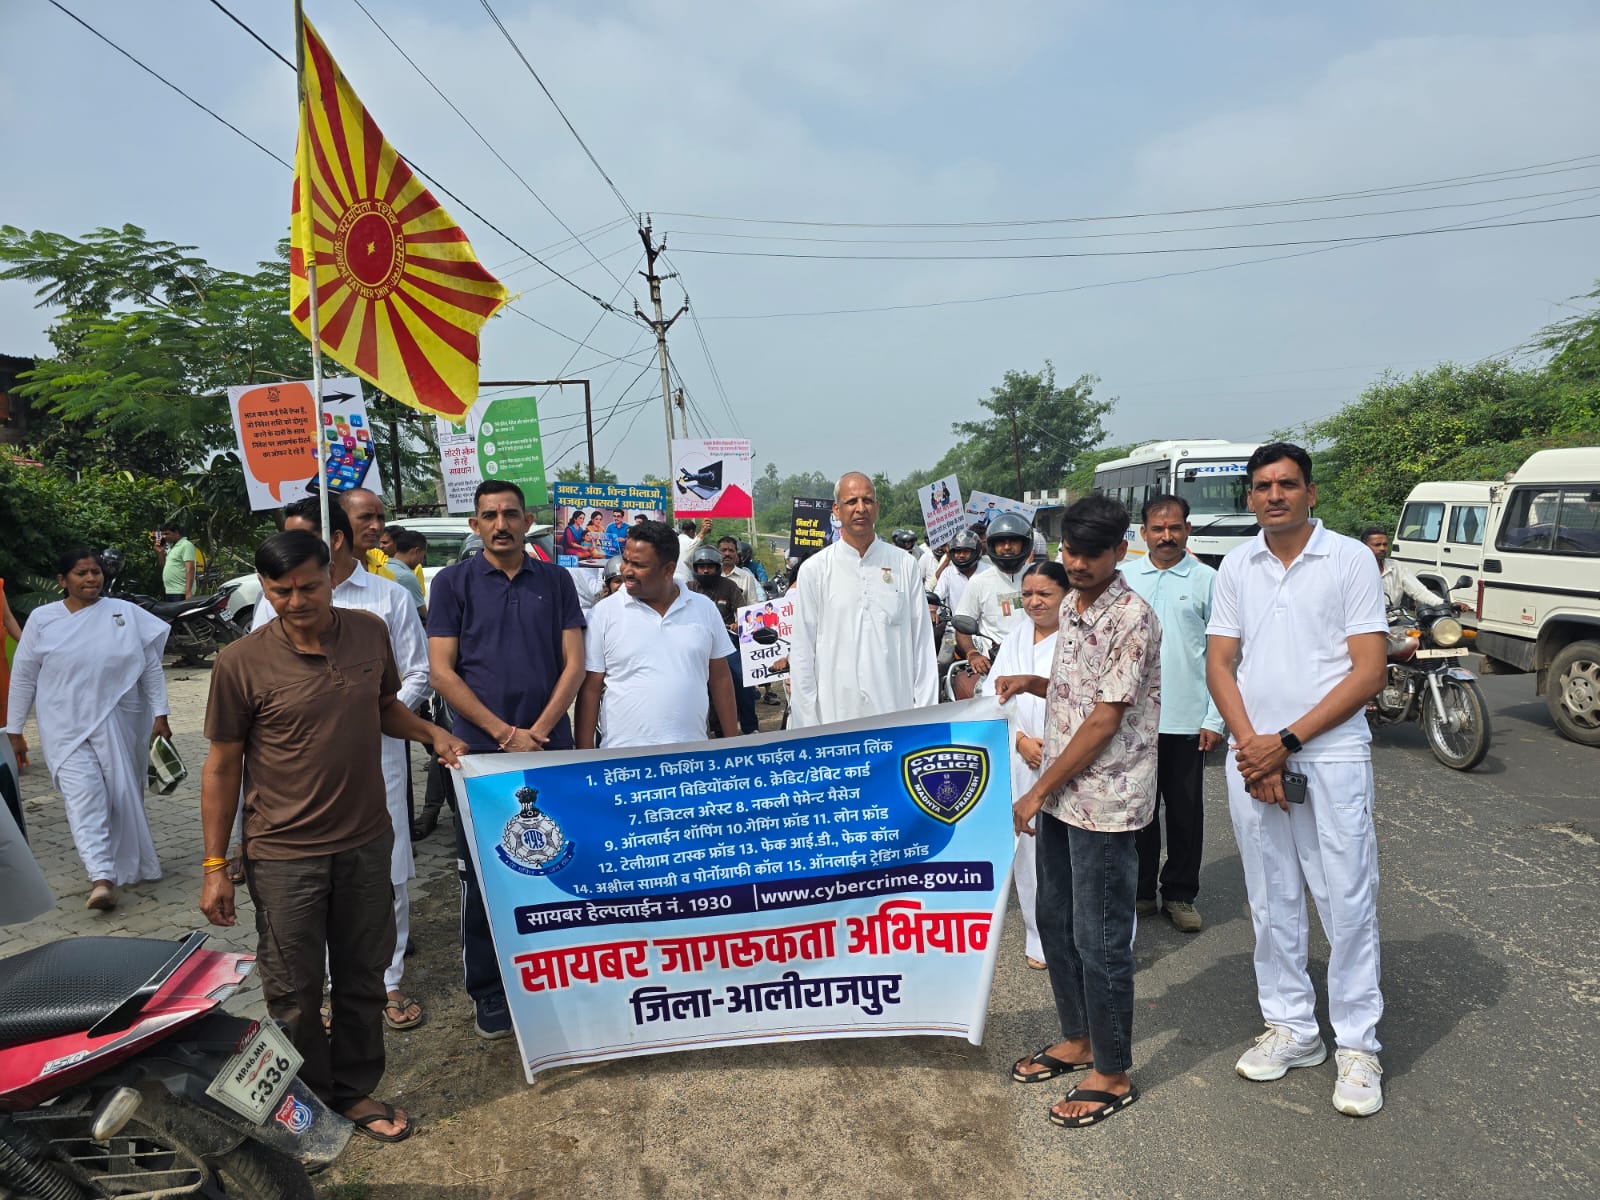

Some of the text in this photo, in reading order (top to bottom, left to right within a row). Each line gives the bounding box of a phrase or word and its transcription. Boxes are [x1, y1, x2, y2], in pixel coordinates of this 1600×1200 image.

[346, 276, 374, 299] FATHER
[749, 642, 782, 661] खतरे
[585, 738, 893, 787] 1. हेकिंग 2. फिशिंग 3. APK फाईल 4. अनजान लिंक
[910, 753, 980, 767] CYBER
[911, 761, 979, 776] POLICE
[614, 794, 627, 806] 5.
[630, 786, 677, 804] अनजान
[754, 777, 767, 788] 6.
[769, 765, 841, 786] क्रेडिट/डेबिट
[844, 761, 871, 777] कार्ड
[628, 786, 860, 826] 7. डिजिटल अरेस्ट 8. नकली पेमेन्ट मैसेज
[914, 775, 980, 813] MADHYA PRADESH
[598, 862, 618, 874] 12.
[620, 854, 669, 871] टेलीग्राम
[673, 847, 706, 862] टास्क
[709, 842, 736, 858] फ्रॉड
[739, 844, 758, 855] 13.
[760, 837, 786, 852] फेक
[841, 829, 867, 844] फेक
[870, 826, 900, 842] कॉल
[604, 840, 618, 851] 9.
[621, 827, 680, 849] ऑनलाईन
[683, 823, 722, 840] शॉपिंग
[783, 812, 809, 828] फ्रॉड
[813, 814, 831, 825] 11.
[833, 807, 859, 823] लोन
[862, 805, 889, 821] फ्रॉड
[572, 884, 593, 894] 14.
[595, 878, 634, 894] अश्लील
[637, 872, 678, 890] सामग्री
[680, 872, 690, 884] व
[754, 858, 783, 875] कॉल
[787, 860, 806, 871] 15.
[809, 852, 867, 870] ऑनलाईन
[869, 848, 900, 867] ट्रेडिंग
[903, 842, 929, 858] फ्रॉड
[526, 869, 982, 927] सायबर हेल्पलाईन नं. 1930 www.cybercrime.gov.in
[514, 900, 992, 993] सायबर जागरूकता अभियान
[629, 971, 903, 1026] जिला-आलीराजपुर
